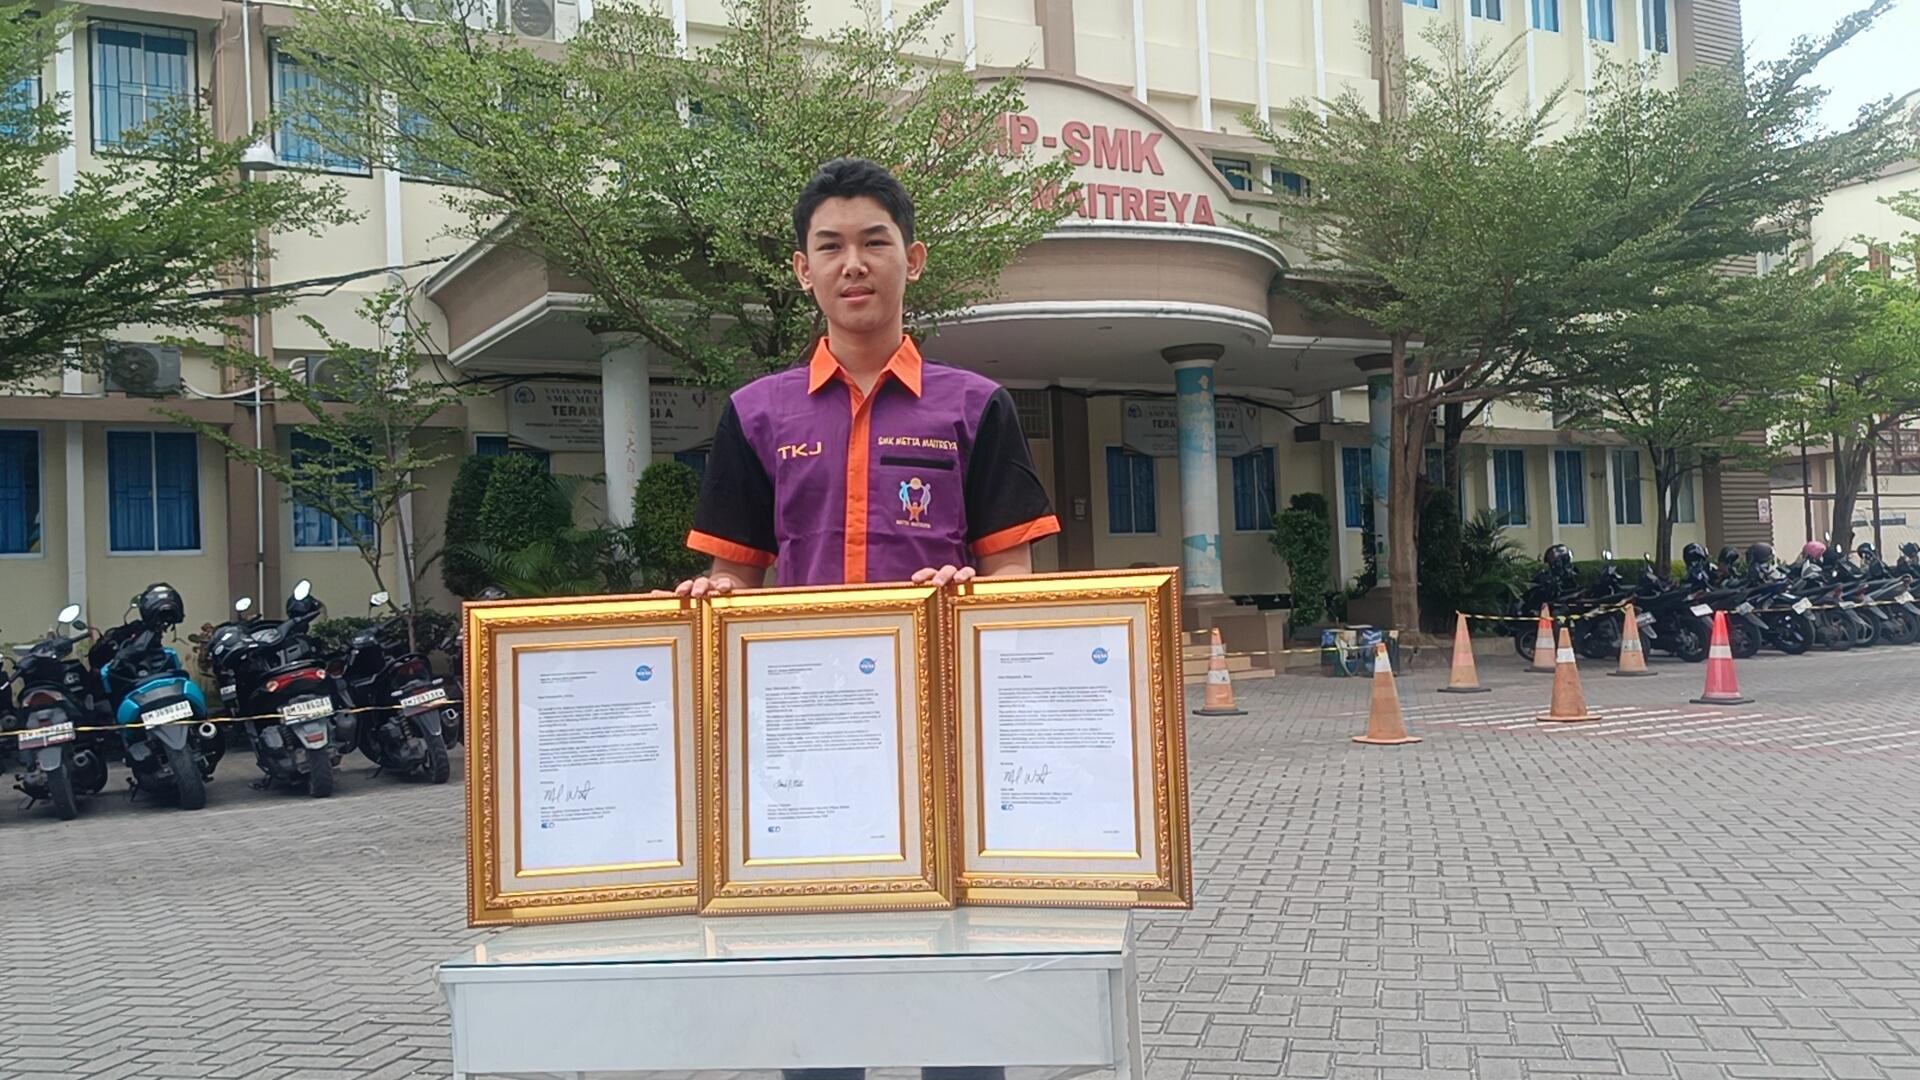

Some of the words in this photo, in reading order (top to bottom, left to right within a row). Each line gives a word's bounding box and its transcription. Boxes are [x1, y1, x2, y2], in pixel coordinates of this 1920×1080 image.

[778, 441, 822, 460] TKJ
[878, 436, 895, 446] SMK
[895, 436, 921, 447] METTA
[922, 438, 958, 451] MAITREYA
